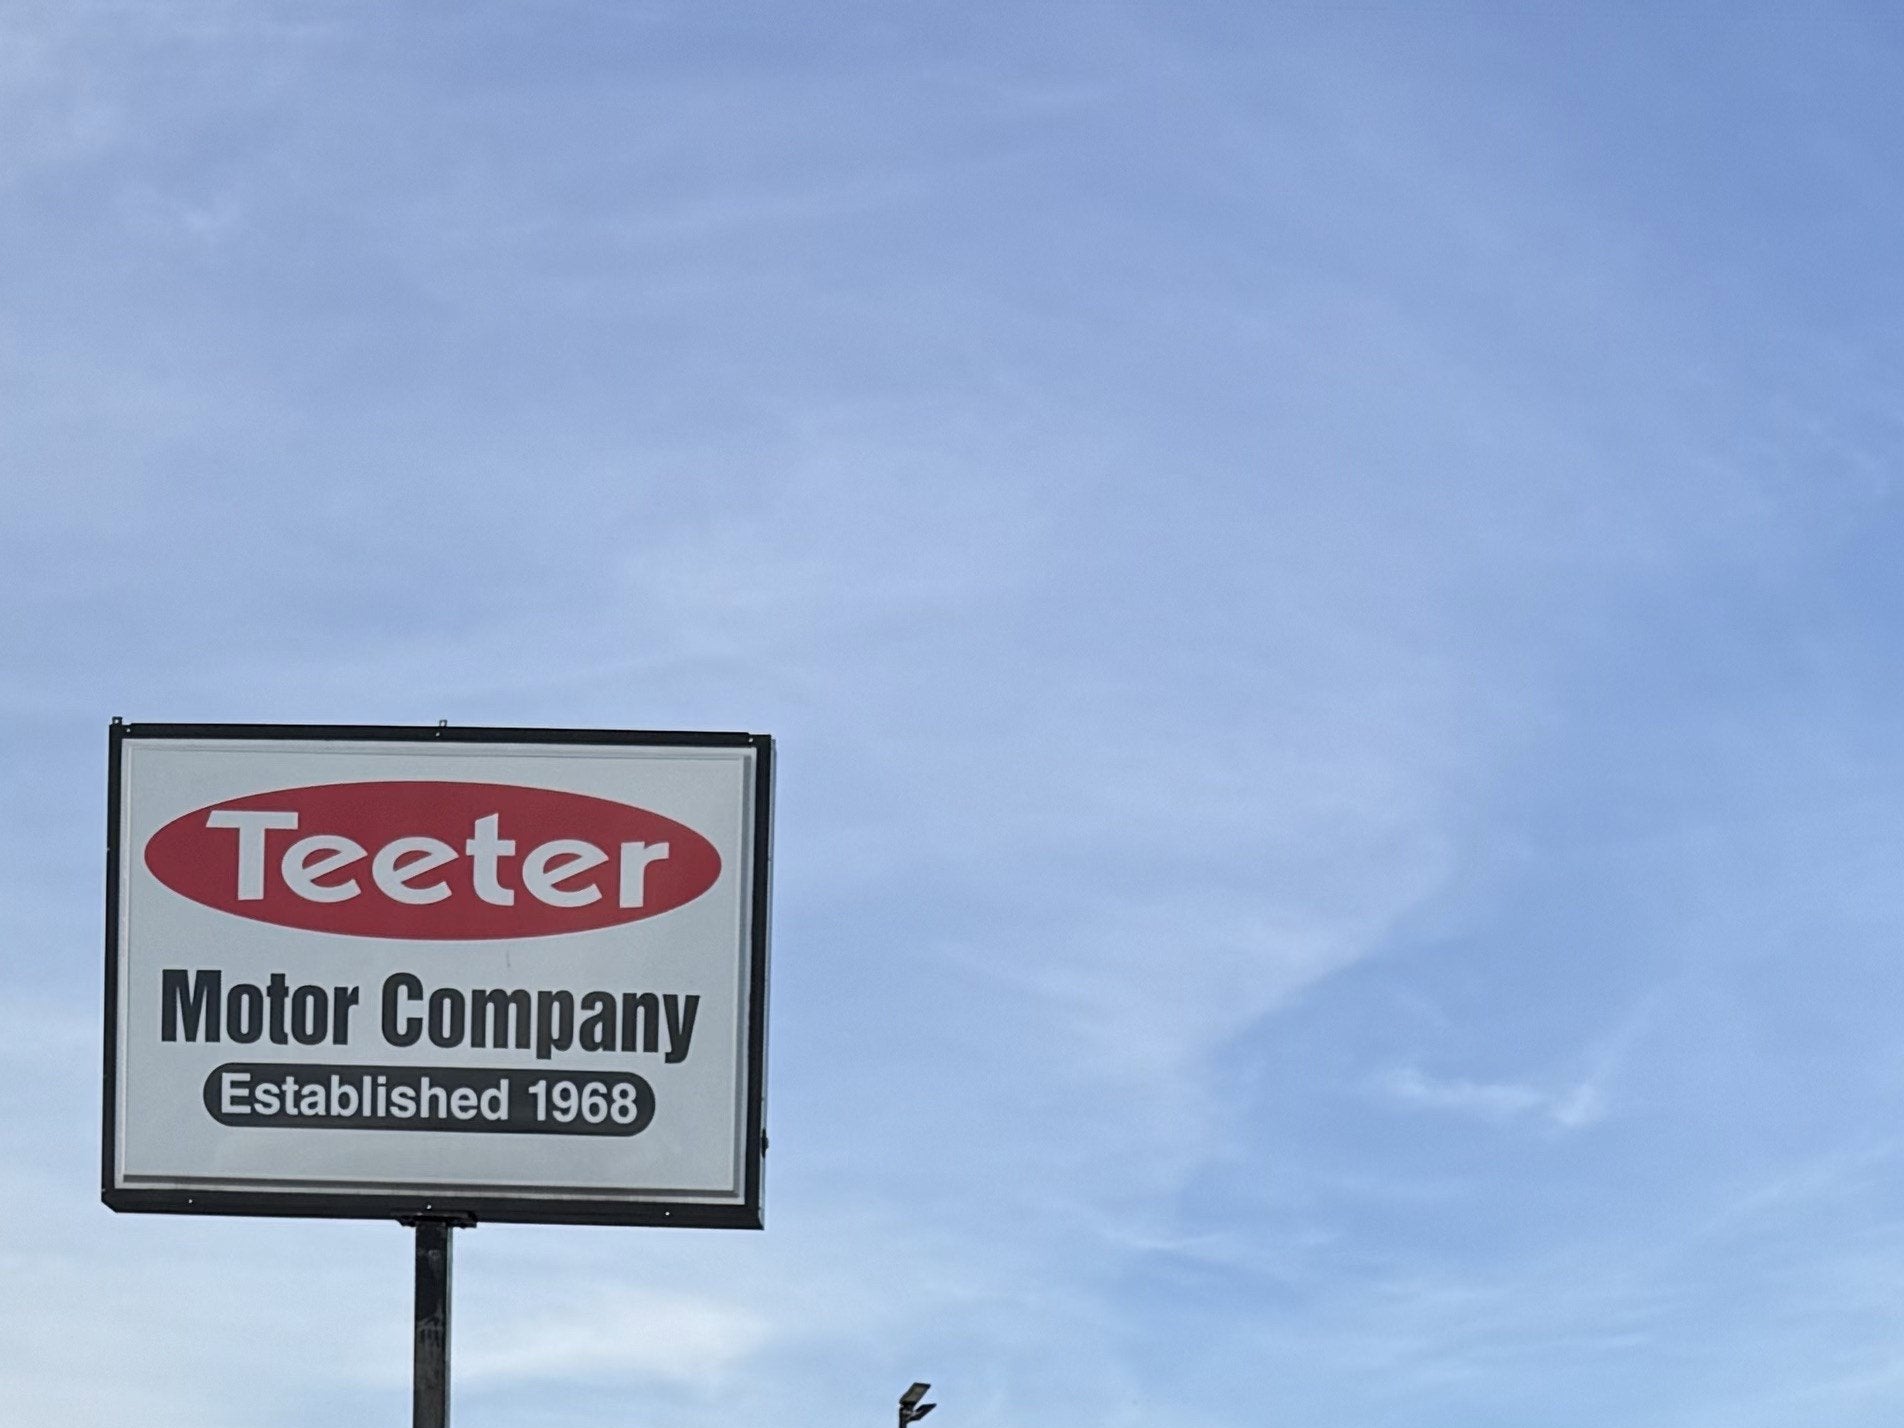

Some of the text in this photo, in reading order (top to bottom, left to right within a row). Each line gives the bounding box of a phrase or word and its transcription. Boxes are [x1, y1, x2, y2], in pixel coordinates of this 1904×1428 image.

[206, 810, 670, 909] Teeter
[161, 968, 700, 1064] Motor Company
[220, 1072, 638, 1125] Established 1968
